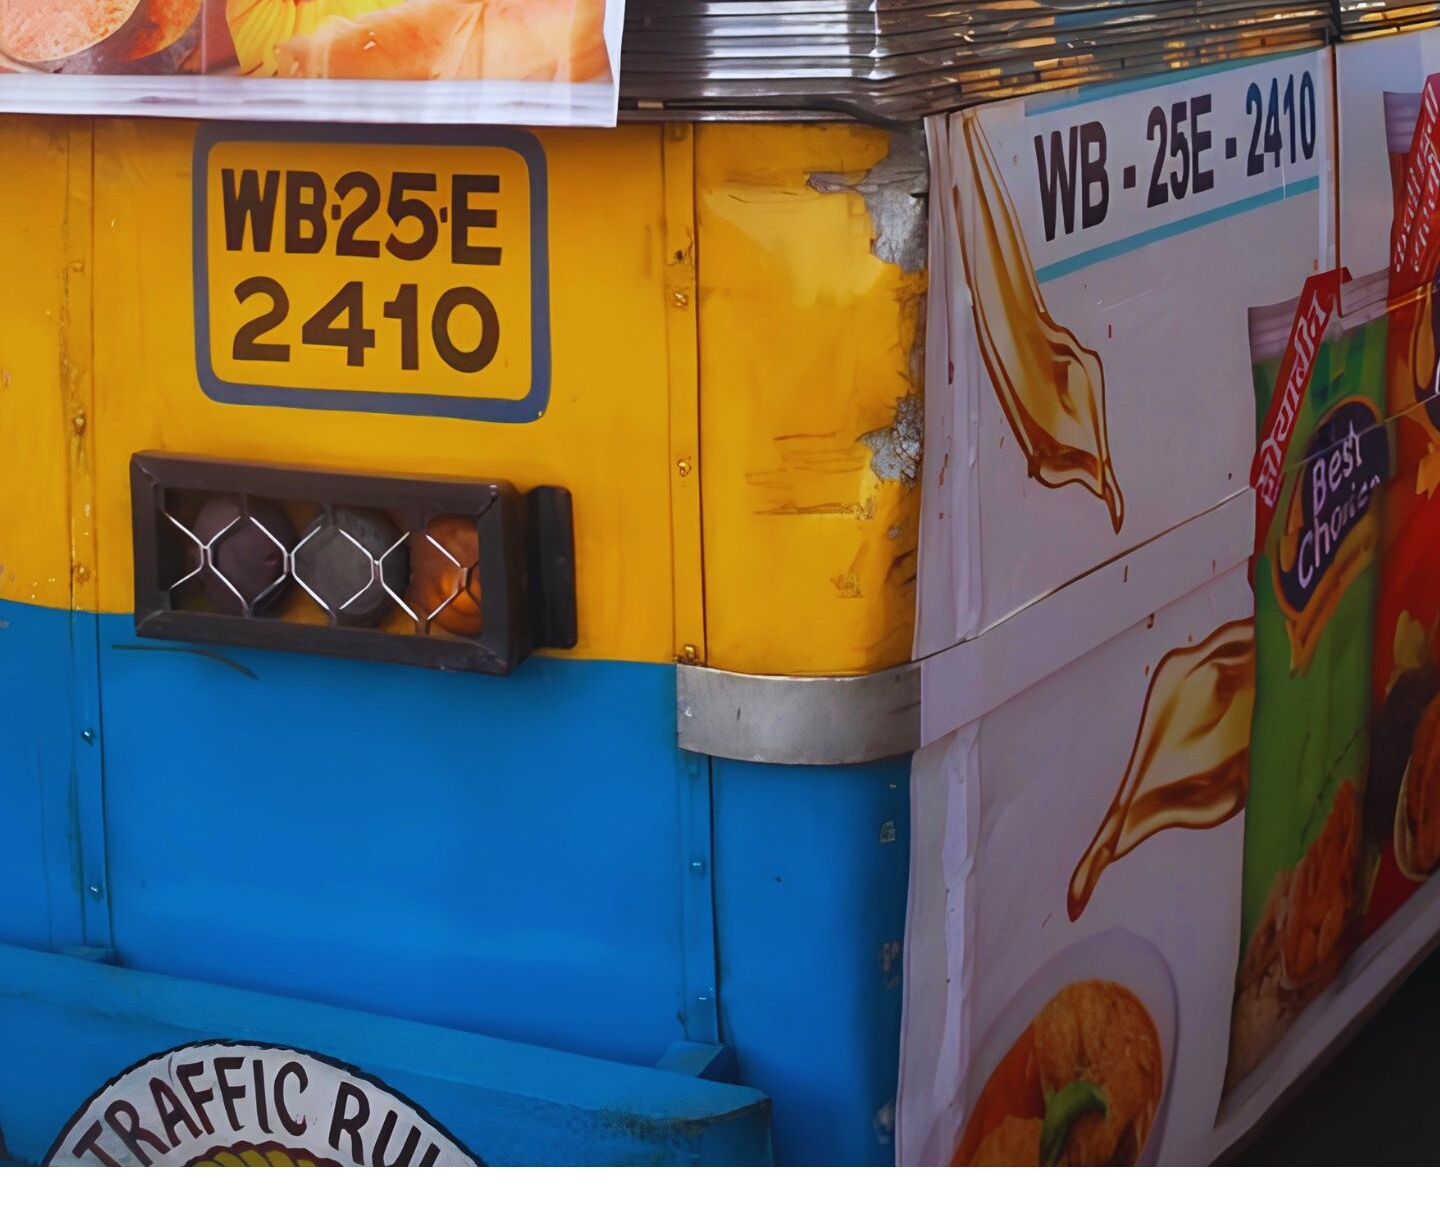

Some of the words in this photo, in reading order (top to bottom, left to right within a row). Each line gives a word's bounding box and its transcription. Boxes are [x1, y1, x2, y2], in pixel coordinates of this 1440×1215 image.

[1034, 120, 1110, 242] WB
[1146, 93, 1215, 209] 25E
[1245, 70, 1317, 177] 2410
[232, 276, 500, 374] 2410
[1312, 419, 1363, 516] Best
[72, 1056, 309, 1167] TRAFFIC
